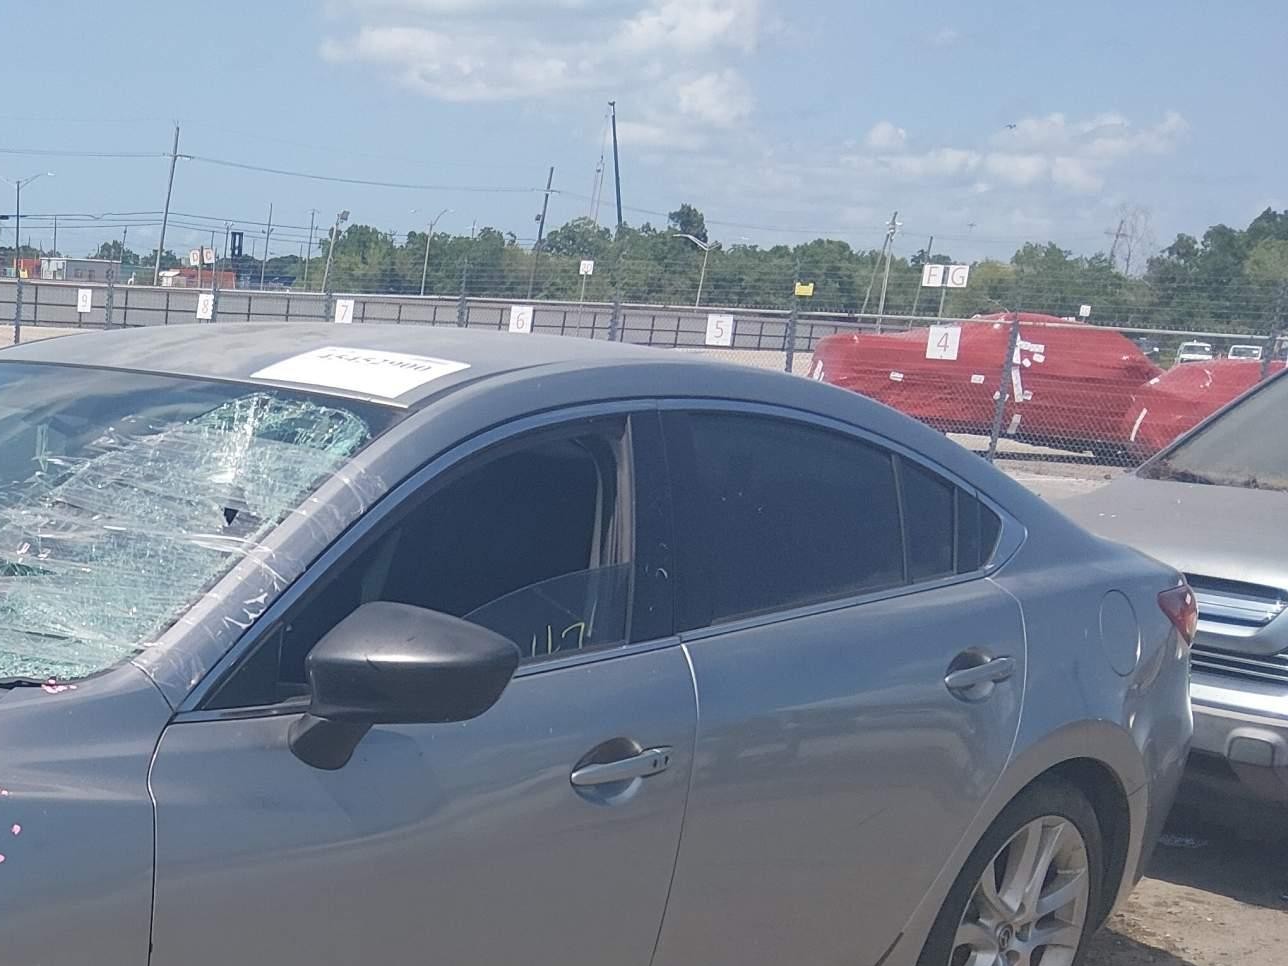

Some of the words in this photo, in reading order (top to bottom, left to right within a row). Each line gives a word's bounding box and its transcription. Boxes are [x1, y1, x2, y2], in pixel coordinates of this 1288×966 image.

[926, 266, 940, 285] F
[951, 266, 967, 286] G
[516, 311, 525, 330] 6
[713, 320, 724, 338] 5
[936, 332, 950, 352] 4
